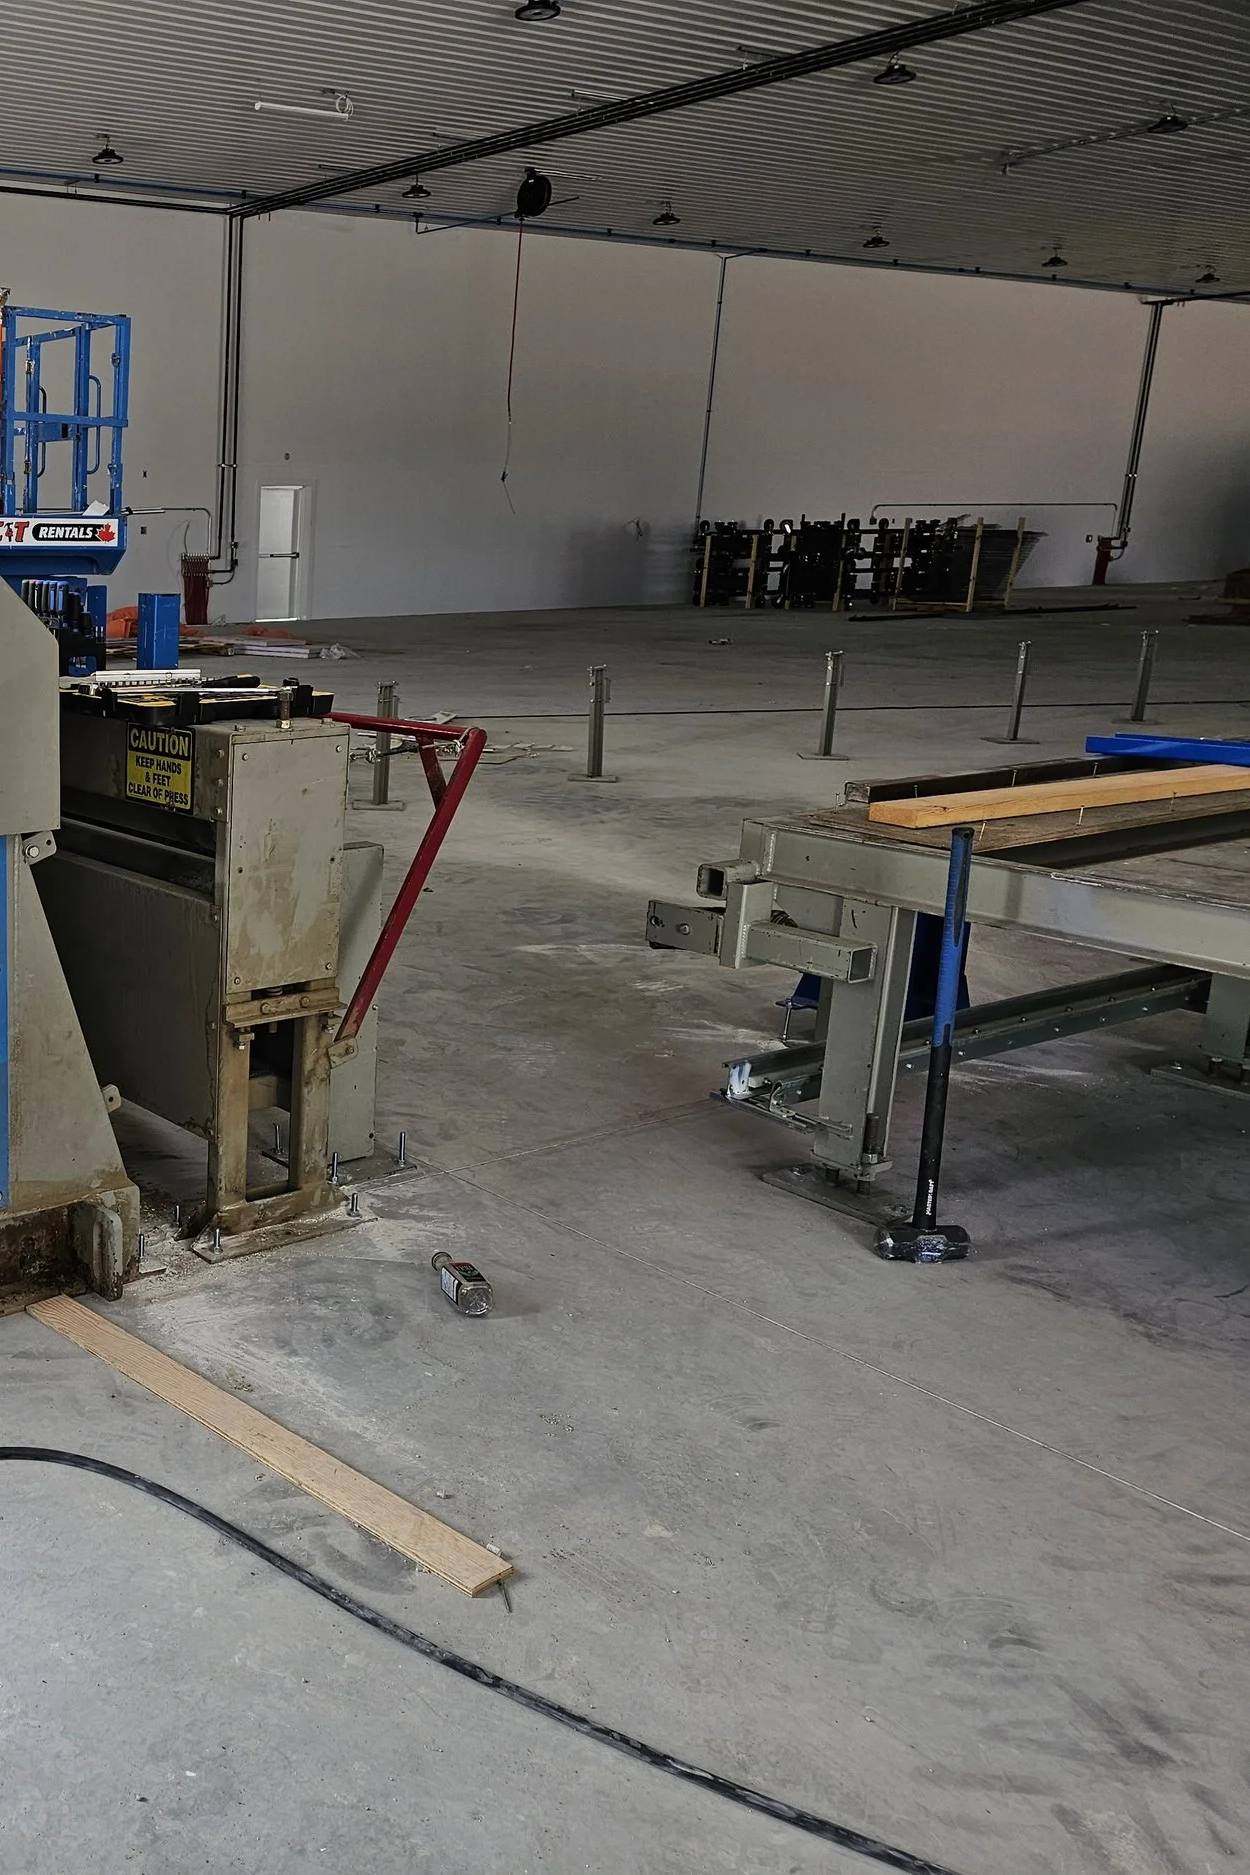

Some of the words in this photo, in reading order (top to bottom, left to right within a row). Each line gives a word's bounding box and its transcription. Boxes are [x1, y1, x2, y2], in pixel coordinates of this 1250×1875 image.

[38, 526, 93, 539] RENTALS
[131, 728, 189, 757] CAUTION
[135, 755, 155, 769] KEEP
[156, 759, 182, 775] HANDS
[145, 771, 151, 783] &
[153, 773, 171, 787] FEET
[128, 782, 151, 797] CLEAR
[153, 787, 162, 800] OF
[164, 790, 189, 806] PRESS
